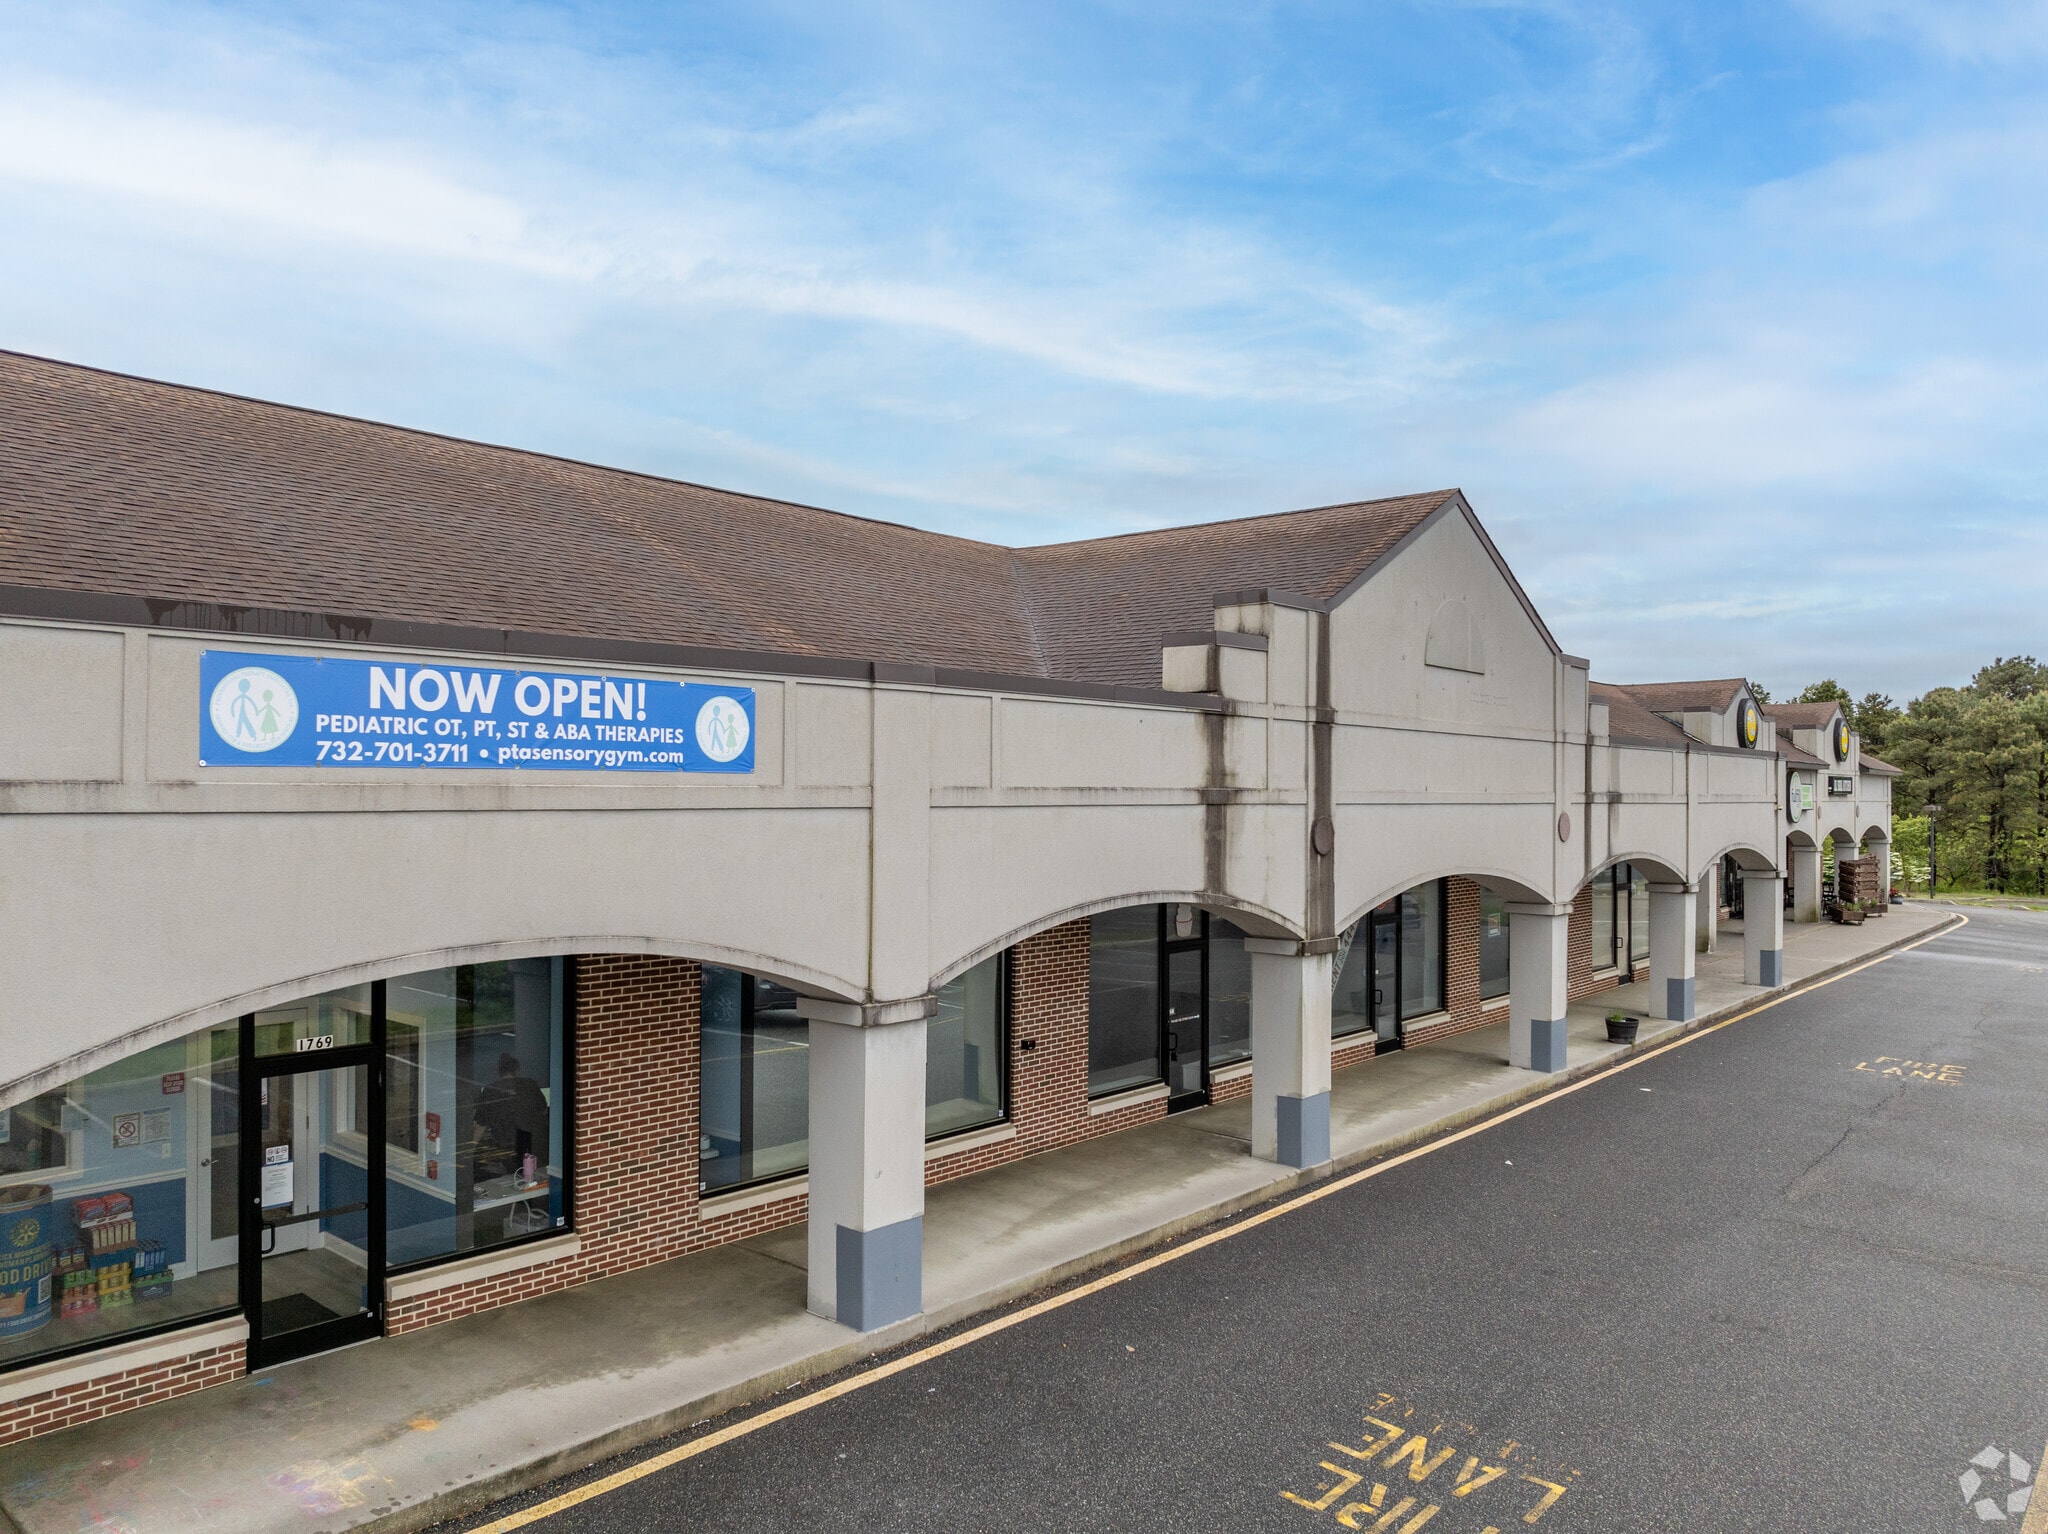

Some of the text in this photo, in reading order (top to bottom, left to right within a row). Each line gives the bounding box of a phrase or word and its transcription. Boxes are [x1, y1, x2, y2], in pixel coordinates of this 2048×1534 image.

[369, 666, 647, 722] NOW OPEN!
[316, 714, 429, 736] PEDIATRIC
[434, 718, 467, 740] OT,
[474, 720, 502, 741] PT,
[507, 721, 529, 739] ST
[534, 722, 550, 740] &
[553, 723, 591, 741] ABA
[595, 725, 684, 744] THERAPIES
[316, 740, 684, 767] 732-701-3711 ptasensorygym.com
[300, 1036, 332, 1050] 1769
[1852, 1062, 1966, 1084] LANE
[1327, 1415, 1568, 1524] LANE
[1279, 1460, 1500, 1534] IRE
